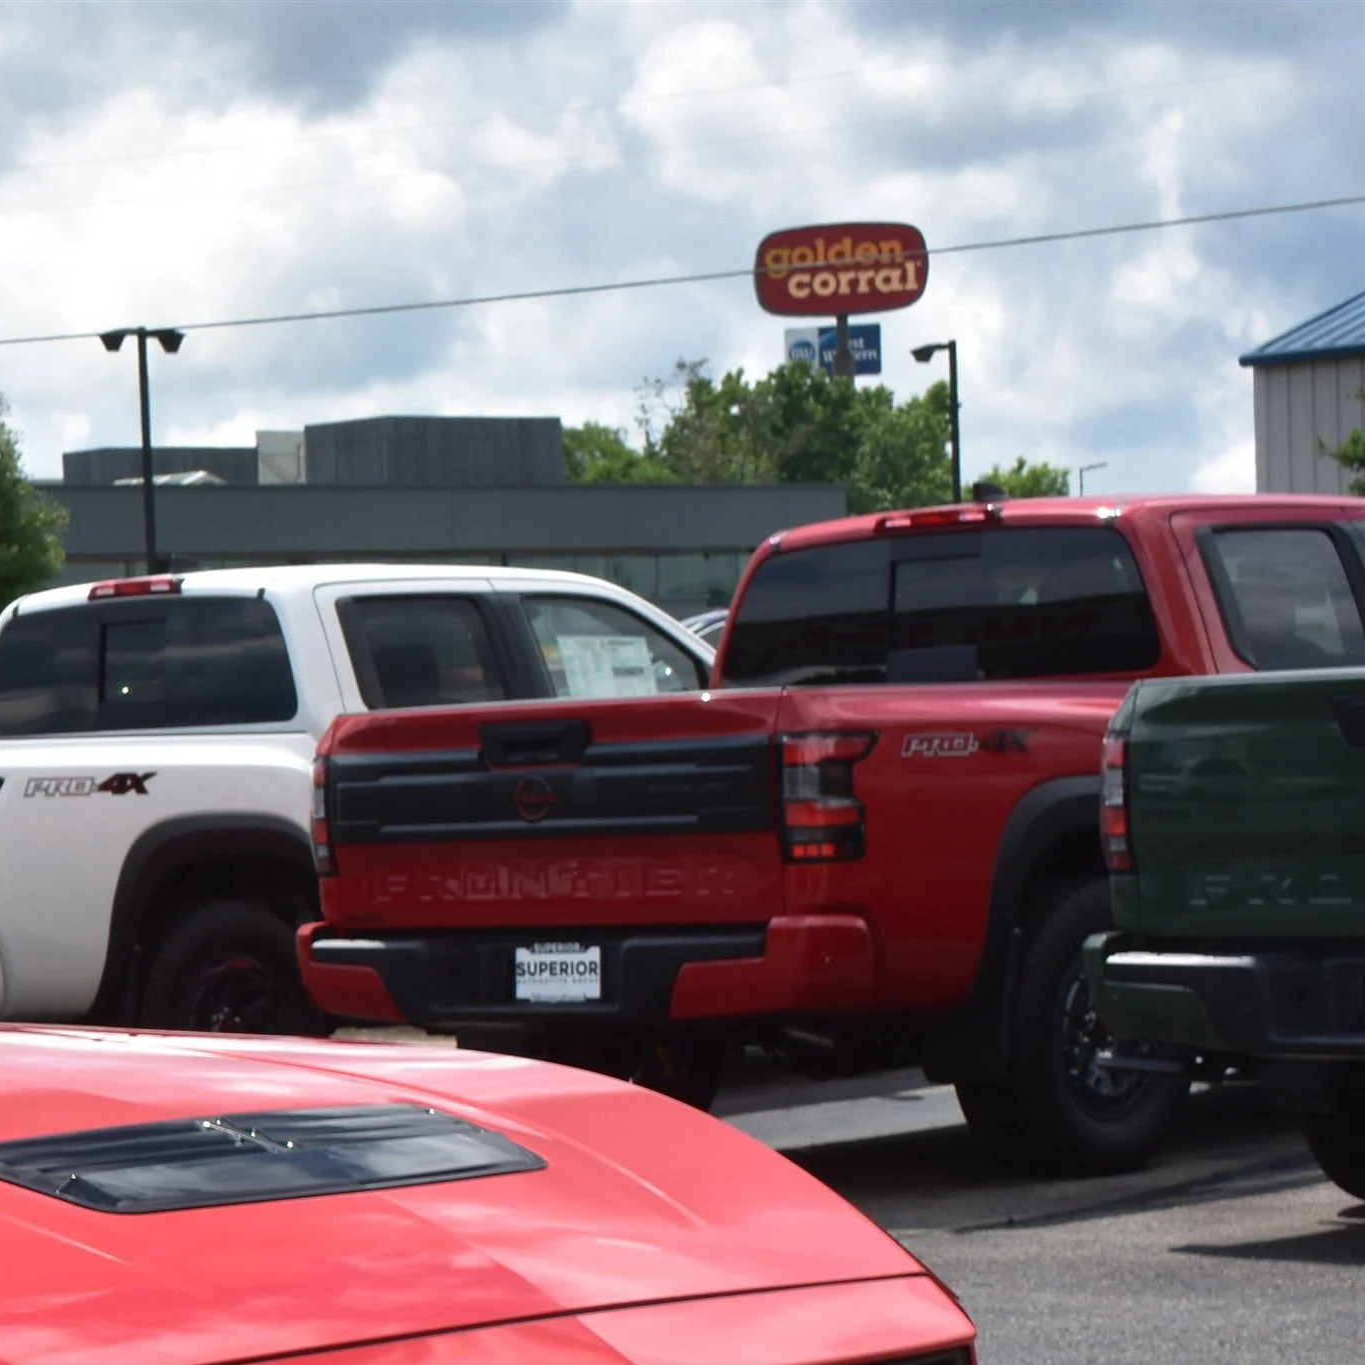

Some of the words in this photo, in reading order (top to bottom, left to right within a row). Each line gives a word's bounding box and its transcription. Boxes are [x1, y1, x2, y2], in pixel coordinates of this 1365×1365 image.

[765, 236, 904, 279] golden
[787, 261, 919, 298] corral
[516, 960, 598, 977] SUPERIOR
